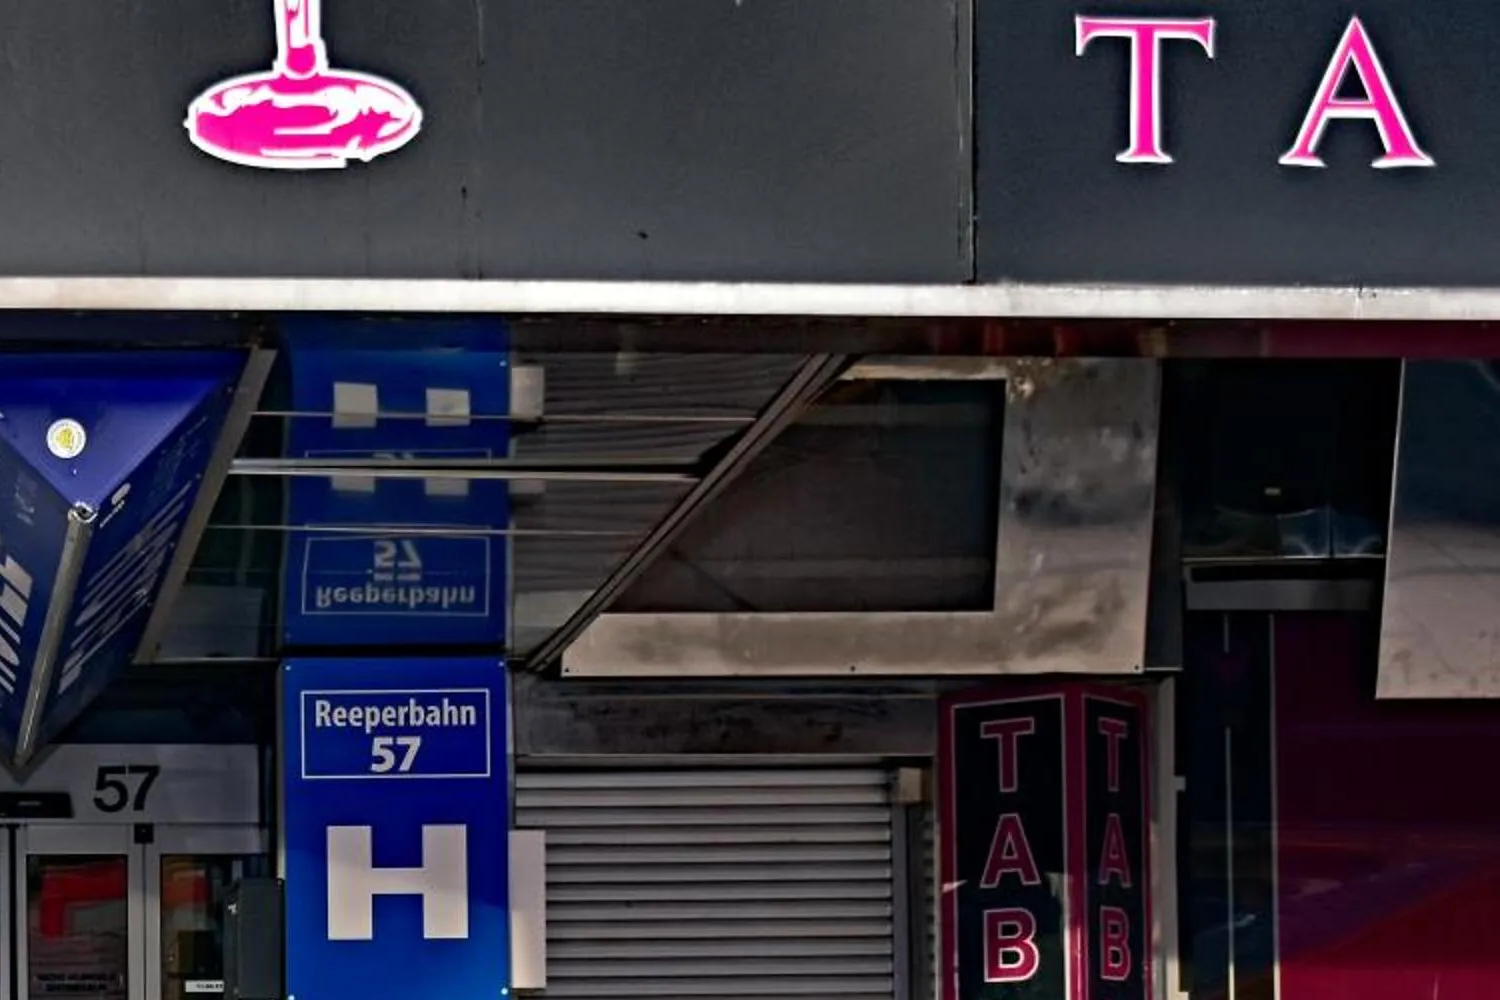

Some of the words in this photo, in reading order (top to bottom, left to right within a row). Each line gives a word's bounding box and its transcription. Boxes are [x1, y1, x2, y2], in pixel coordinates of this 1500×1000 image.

[315, 698, 477, 732] Reeperbahn
[370, 736, 422, 773] 57
[93, 765, 160, 813] 57
